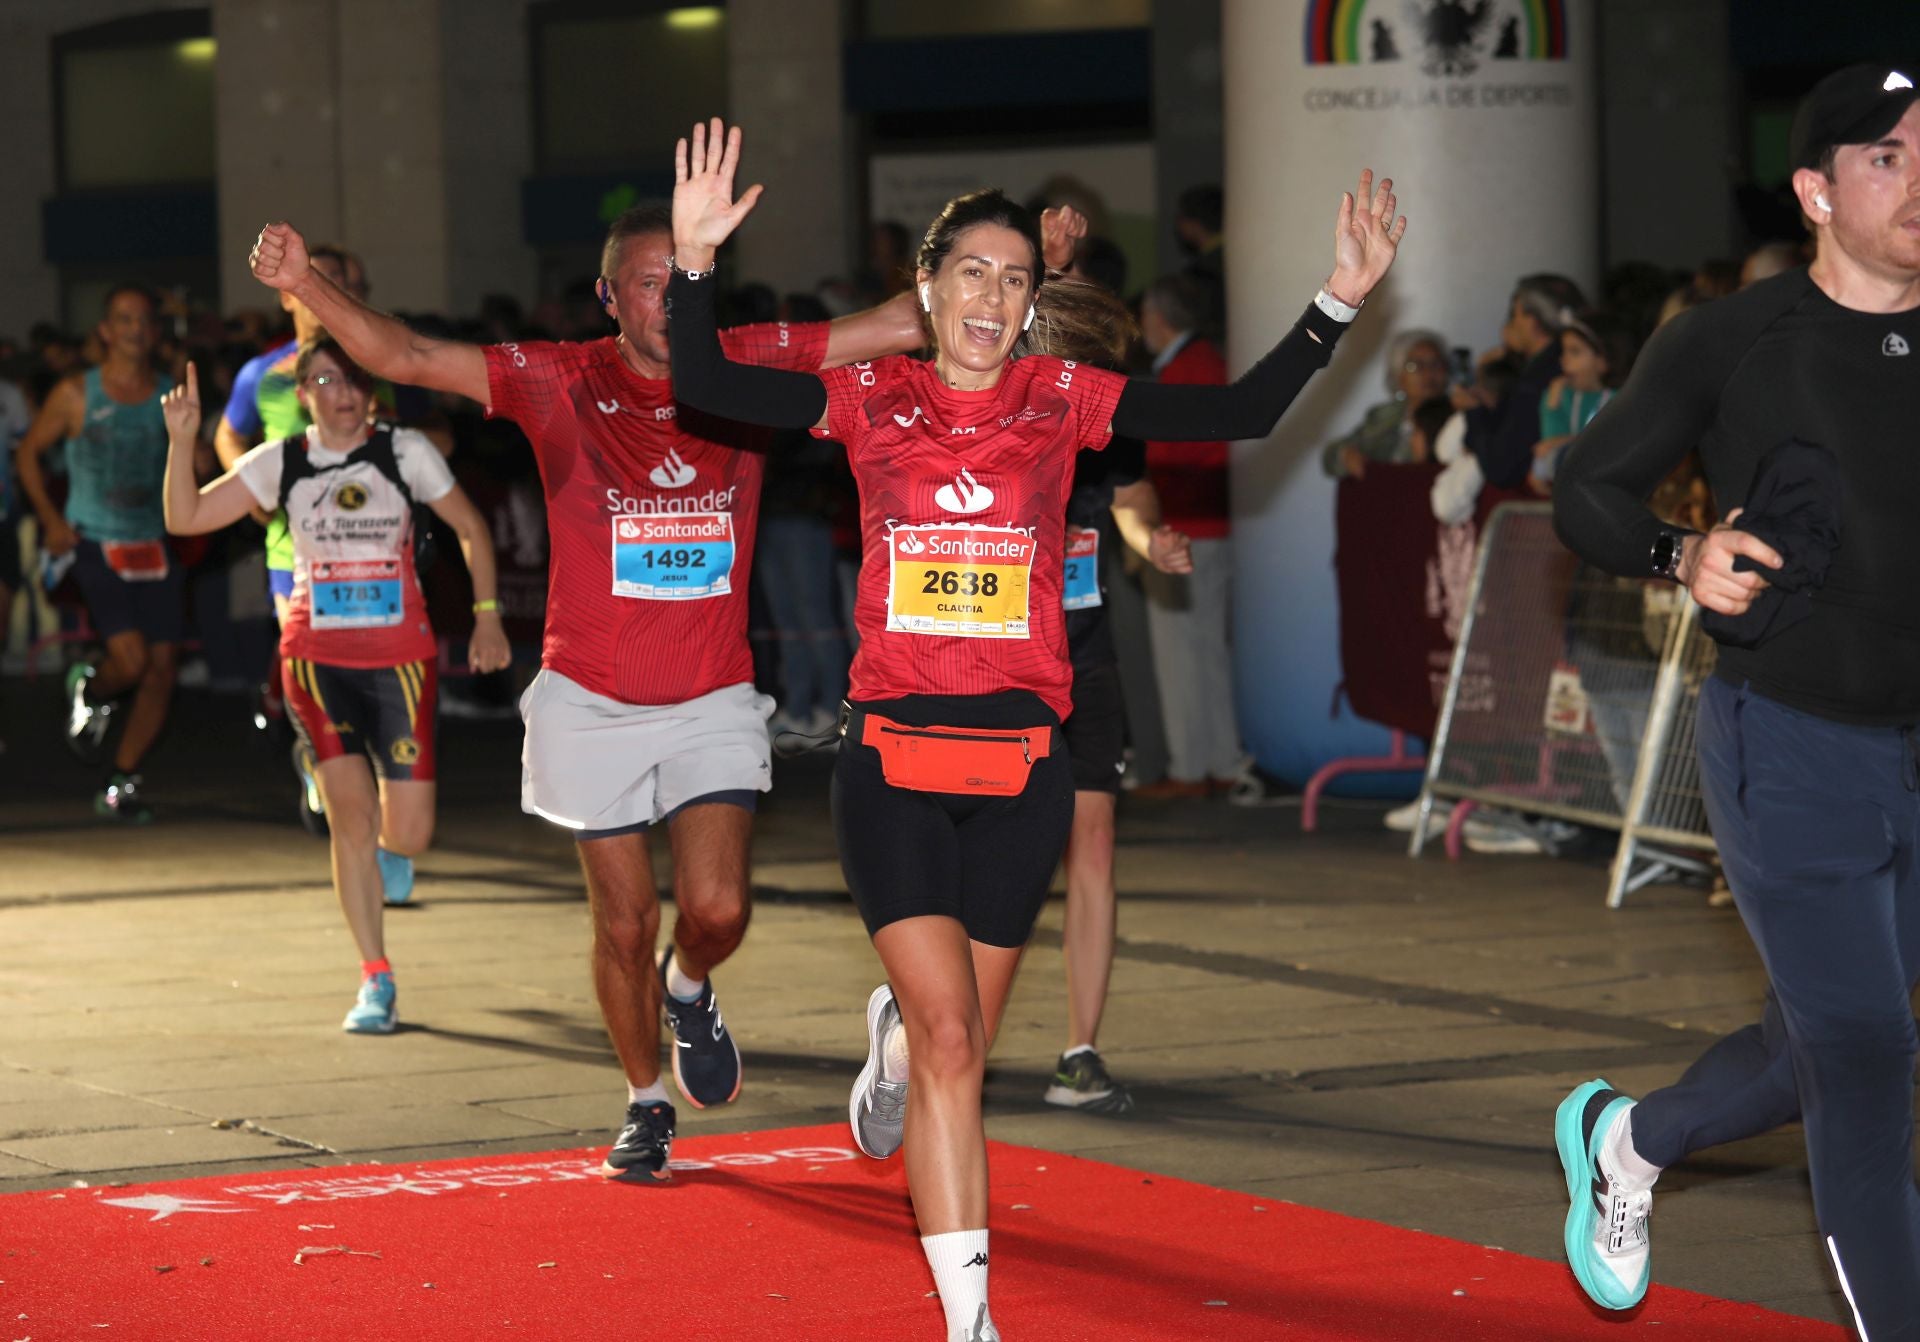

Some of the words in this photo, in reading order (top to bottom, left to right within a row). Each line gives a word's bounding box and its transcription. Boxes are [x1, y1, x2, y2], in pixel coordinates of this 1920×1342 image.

[1303, 86, 1441, 112] CONCEJAA
[1446, 85, 1475, 109] DE
[606, 485, 737, 514] Santander
[643, 520, 727, 539] Santander
[928, 535, 1030, 558] Santander
[642, 548, 706, 569] 1492
[660, 574, 689, 582] JESUS
[921, 569, 999, 597] 2638
[937, 603, 984, 614] CLAUDIA
